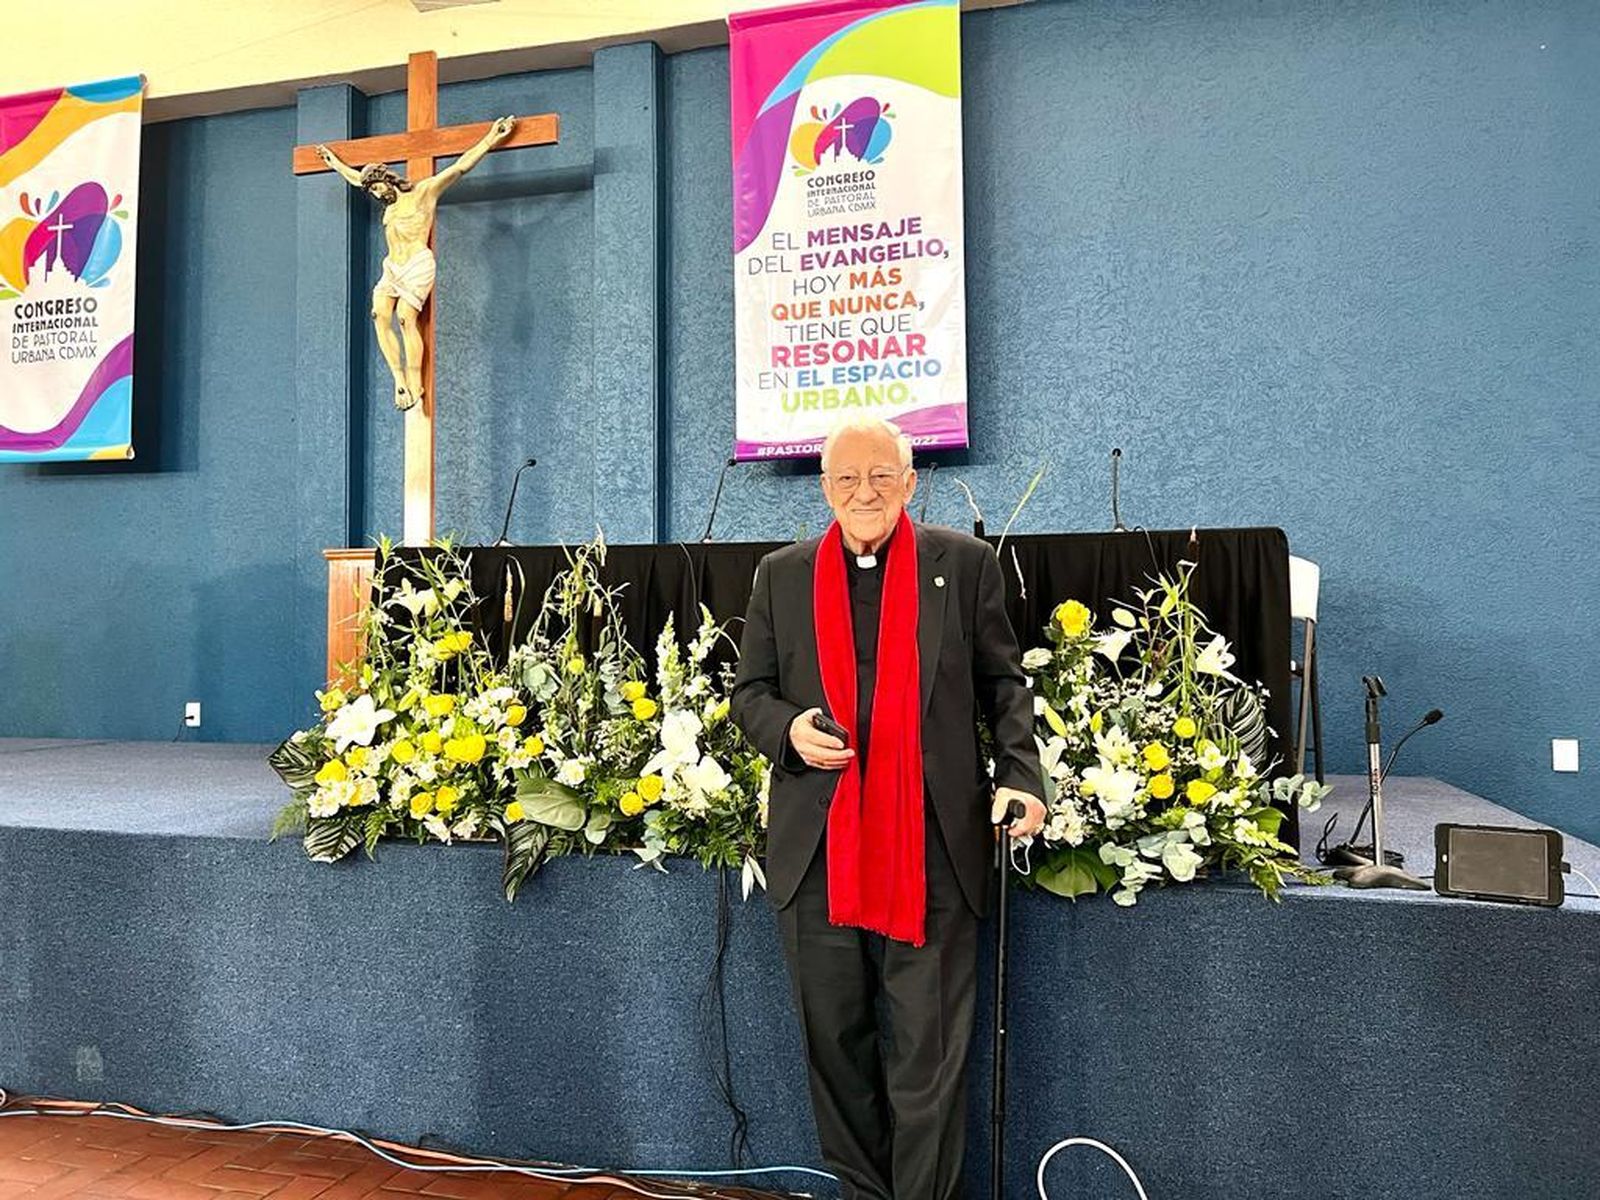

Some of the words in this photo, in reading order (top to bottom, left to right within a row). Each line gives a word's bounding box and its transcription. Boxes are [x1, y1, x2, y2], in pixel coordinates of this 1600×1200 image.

[807, 170, 876, 188] CONGRESO
[807, 182, 876, 198] INTERNACIONAL
[807, 198, 821, 208] DE
[824, 191, 876, 205] PASTORAL
[807, 204, 846, 218] URBANA
[848, 201, 876, 213] CDMX
[772, 232, 800, 251] EL
[807, 217, 922, 248] MENSAJE
[748, 255, 792, 275] DEL
[800, 239, 949, 272] EVANGELIO,
[793, 274, 842, 296] HOY
[849, 265, 902, 290] MÁS
[14, 297, 98, 319] CONGRESO
[771, 301, 821, 321] QUE
[829, 290, 925, 317] NUNCA,
[12, 316, 99, 334] INTERNACIONAL
[785, 320, 852, 343] TIENE
[860, 313, 912, 336] QUE
[12, 335, 29, 349] DE
[33, 330, 98, 346] PASTORAL
[771, 332, 927, 369] RESONAR
[12, 348, 57, 364] URBANA
[58, 345, 98, 360] CDMX
[758, 372, 788, 390] EN
[797, 369, 825, 388] EL
[832, 359, 942, 385] ESPACIO
[781, 382, 917, 413] URBANO.
